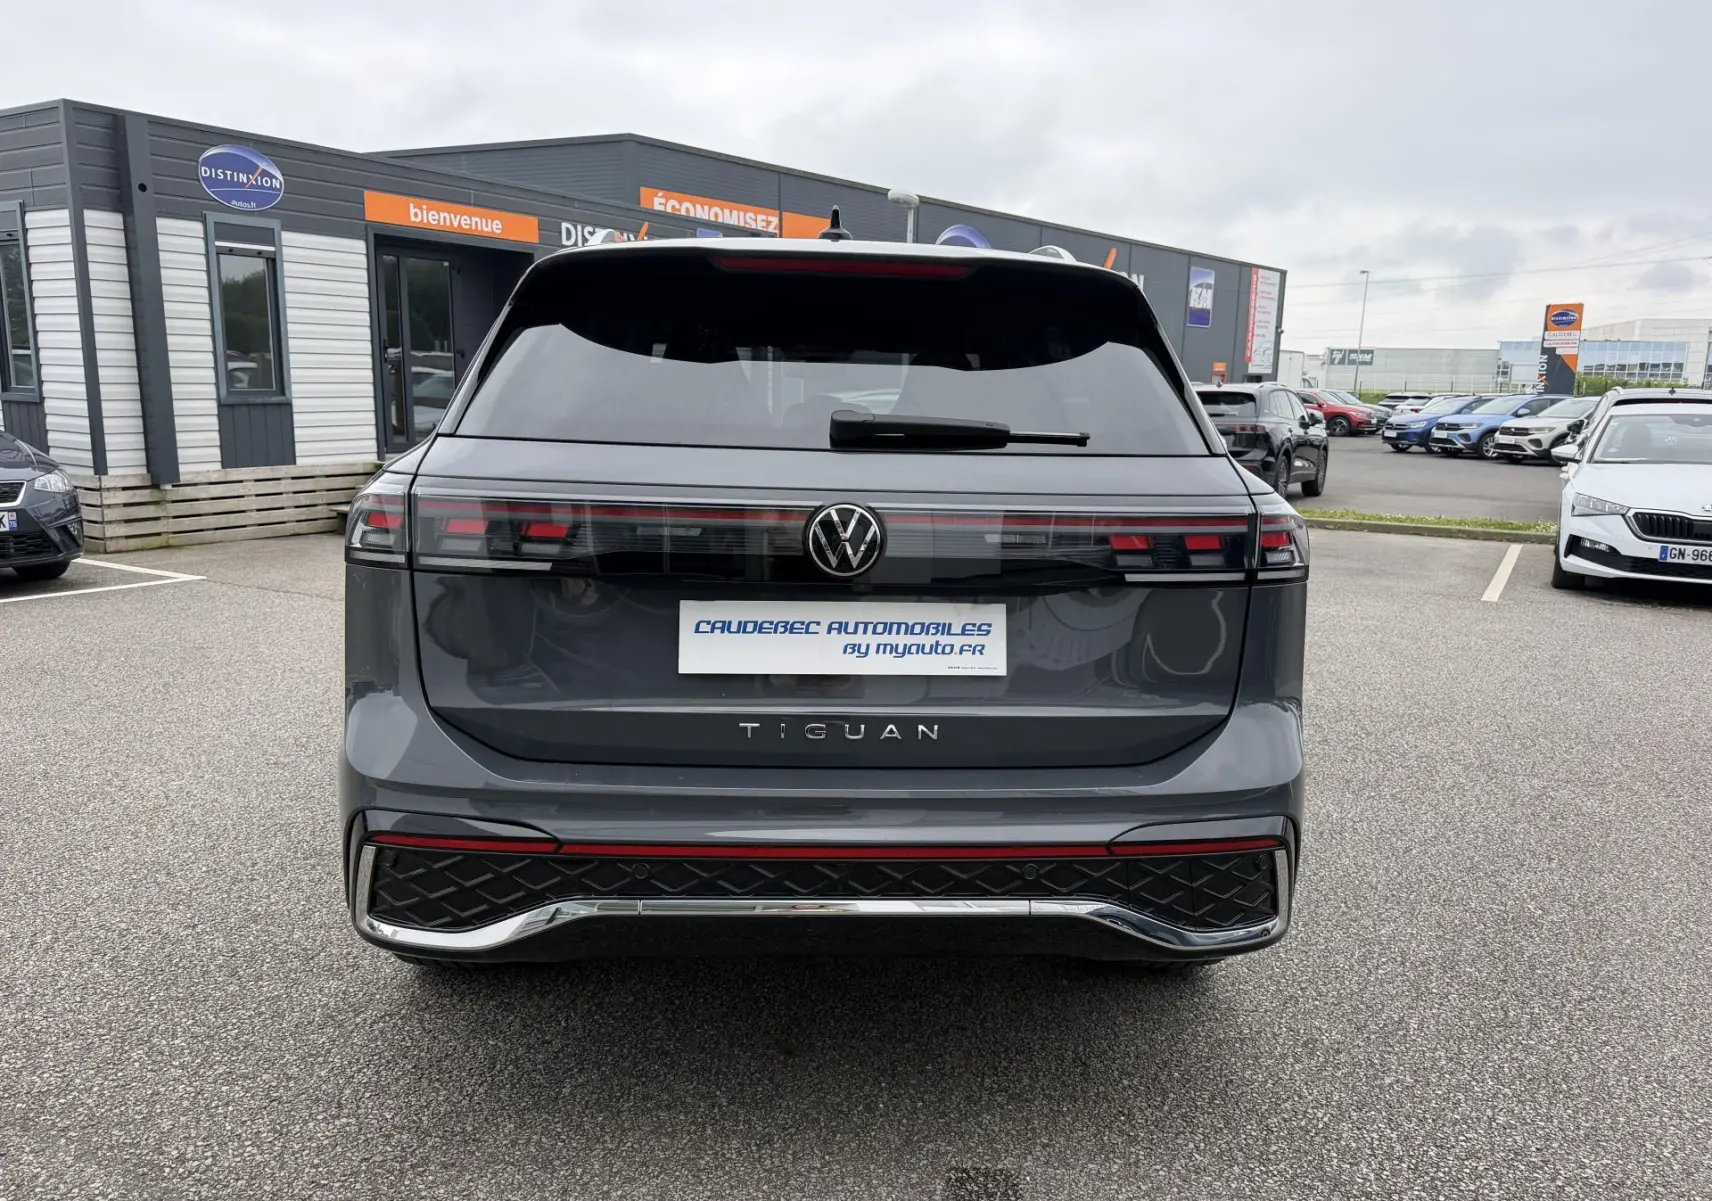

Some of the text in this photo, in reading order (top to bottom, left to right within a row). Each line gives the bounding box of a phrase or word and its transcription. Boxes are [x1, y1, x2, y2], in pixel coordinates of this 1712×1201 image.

[201, 166, 281, 189] DISTINXION
[409, 203, 503, 234] bienvenue
[653, 192, 779, 233] ÉCONOMISEZ
[694, 620, 993, 637] CAUDEBEC AUTOMOBILES
[739, 723, 938, 739] TIGUAN
